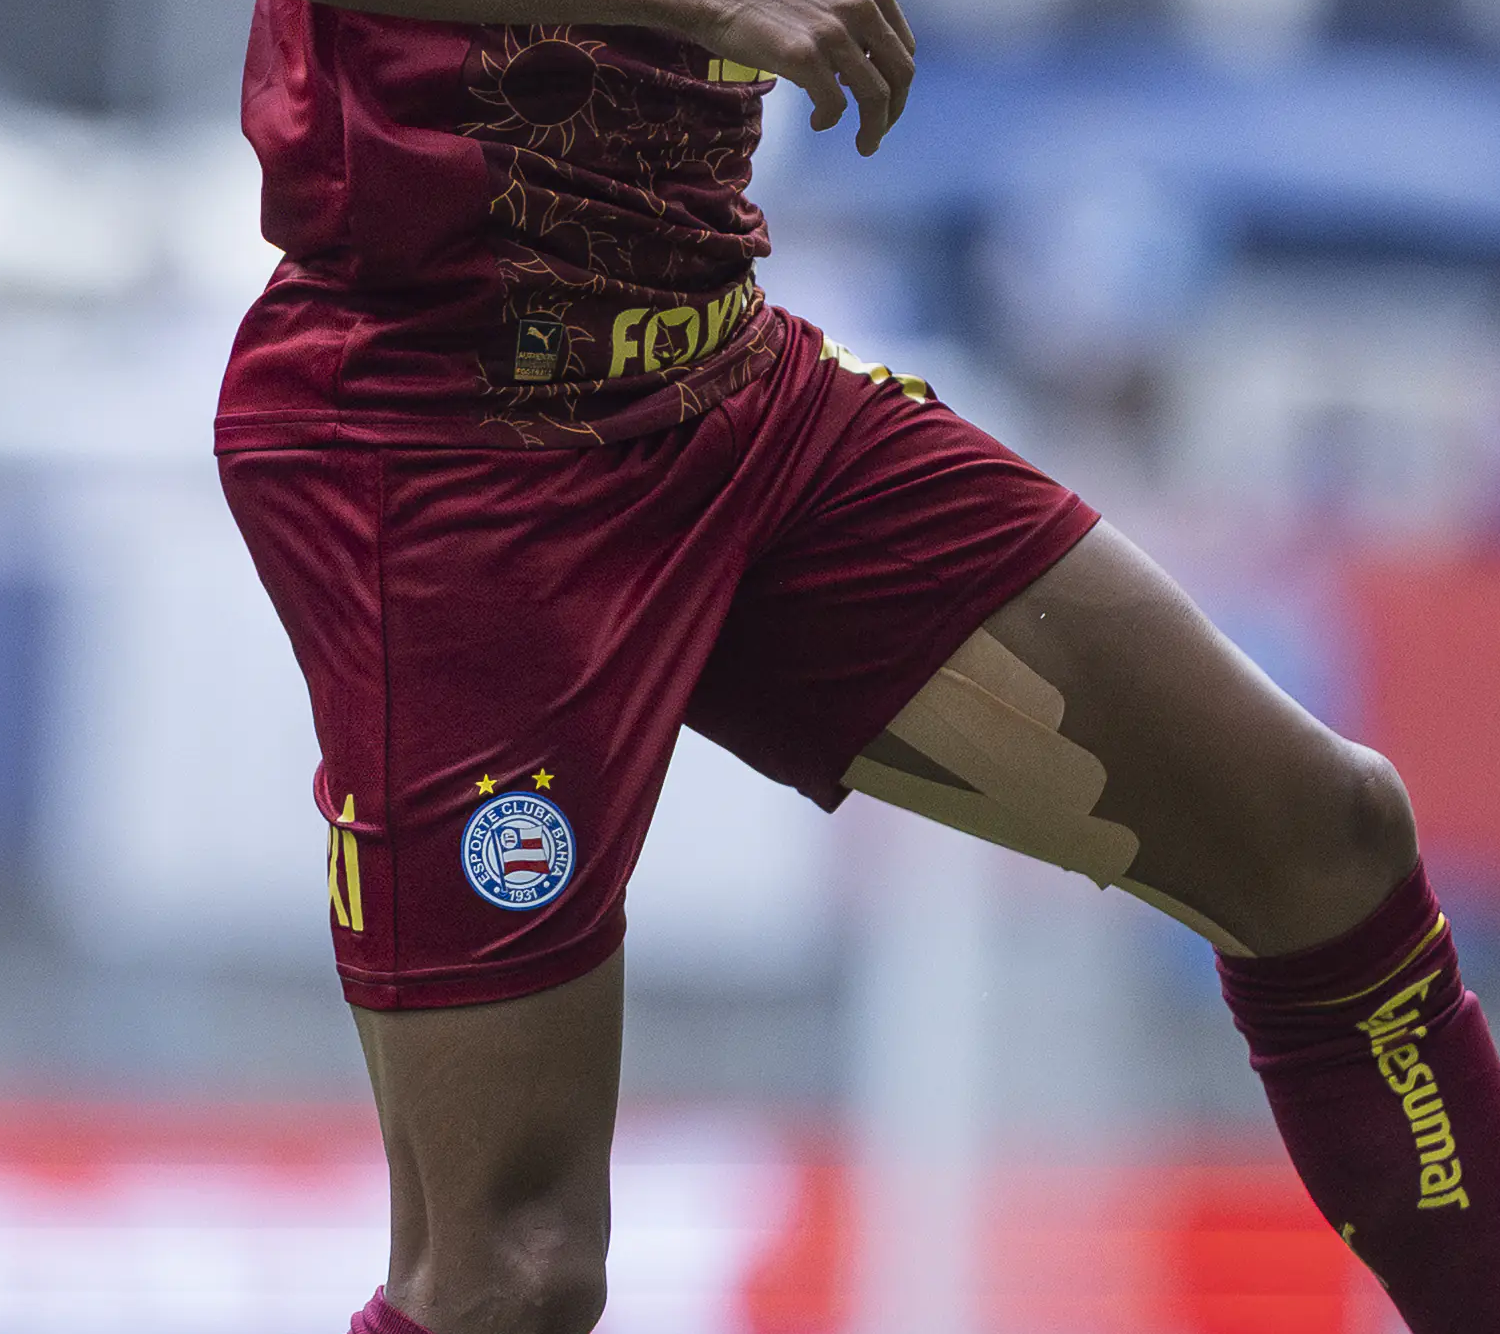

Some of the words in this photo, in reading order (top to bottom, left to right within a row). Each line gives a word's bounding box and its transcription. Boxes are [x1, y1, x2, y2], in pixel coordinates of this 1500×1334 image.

[470, 810, 500, 886] ESPORTE
[501, 801, 555, 827] CLUBE
[550, 827, 568, 877] BAHIA
[508, 887, 538, 902] 1931
